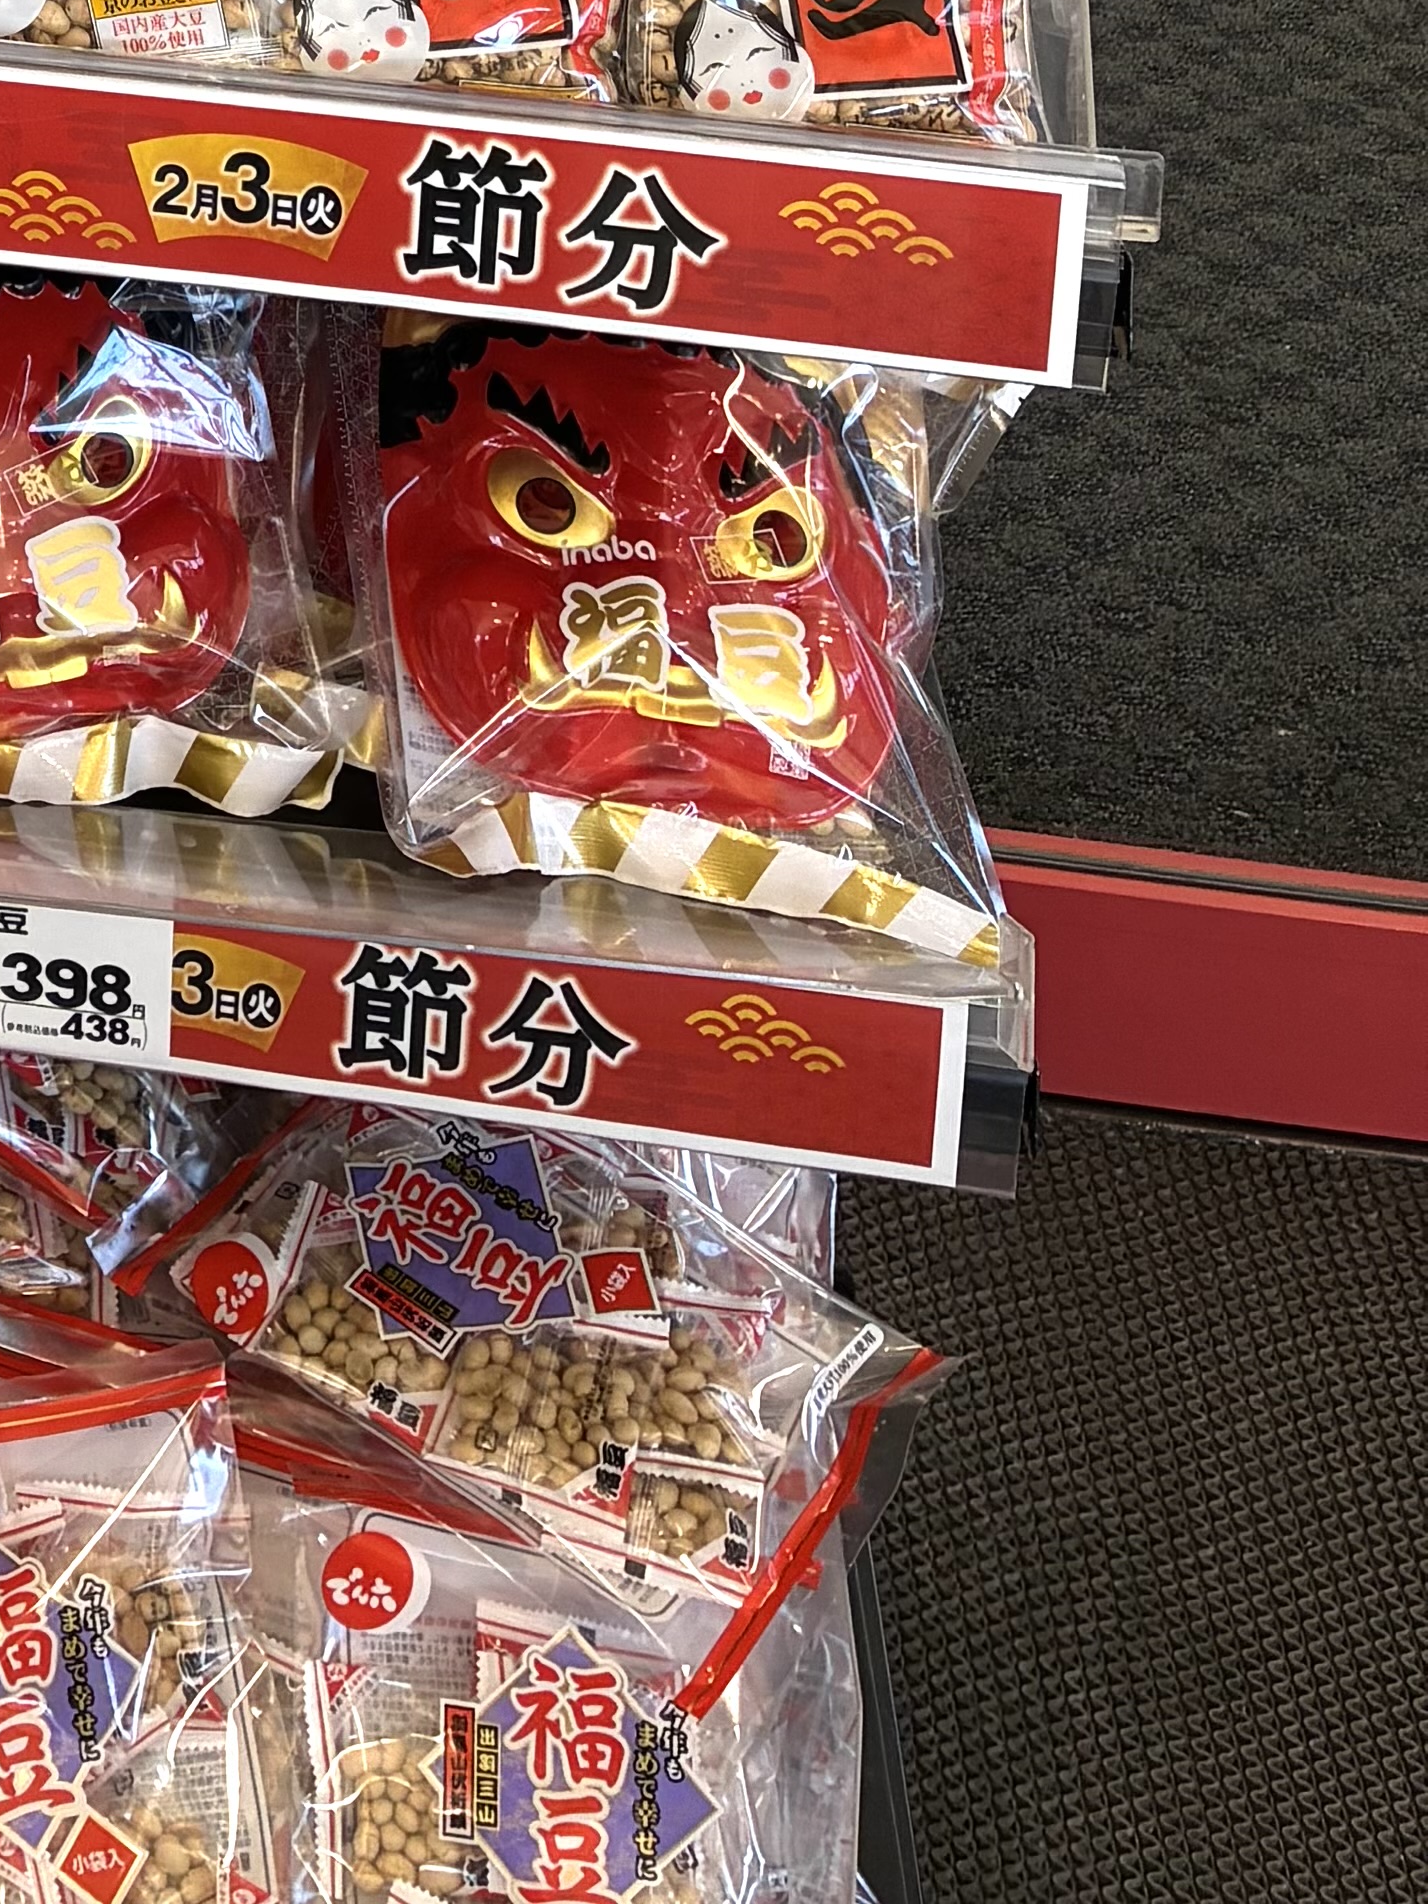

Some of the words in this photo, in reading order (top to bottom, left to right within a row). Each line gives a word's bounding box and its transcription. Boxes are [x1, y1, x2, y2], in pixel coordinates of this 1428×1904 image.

[110, 8, 207, 37] 国内産大豆
[560, 537, 657, 567] inaba
